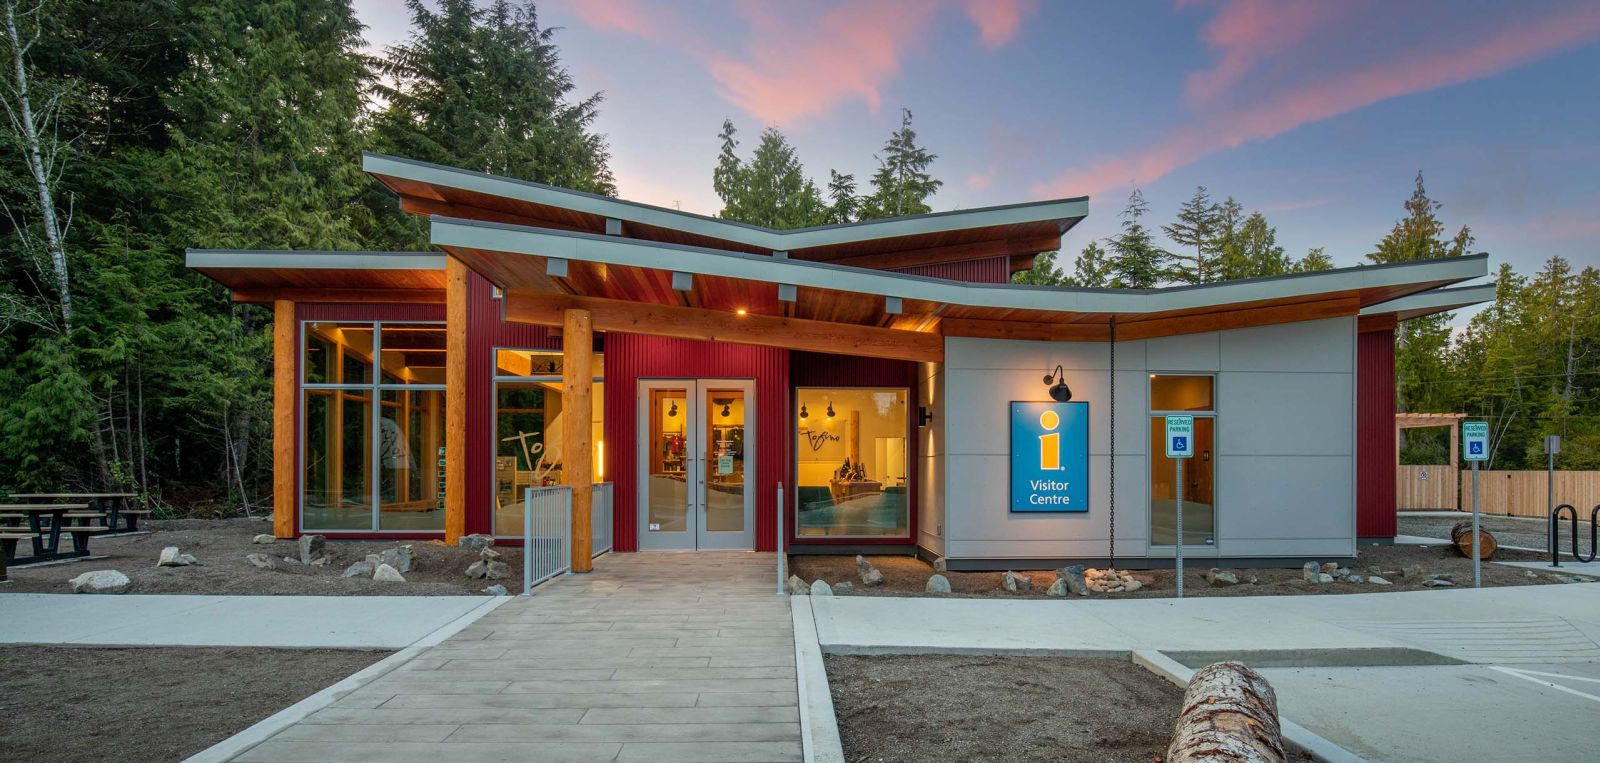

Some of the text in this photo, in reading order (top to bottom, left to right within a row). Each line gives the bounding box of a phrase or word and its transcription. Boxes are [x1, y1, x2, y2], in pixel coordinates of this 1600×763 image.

[799, 430, 840, 451] Tofino
[1030, 480, 1069, 491] Visitor
[1029, 494, 1070, 504] Centre
